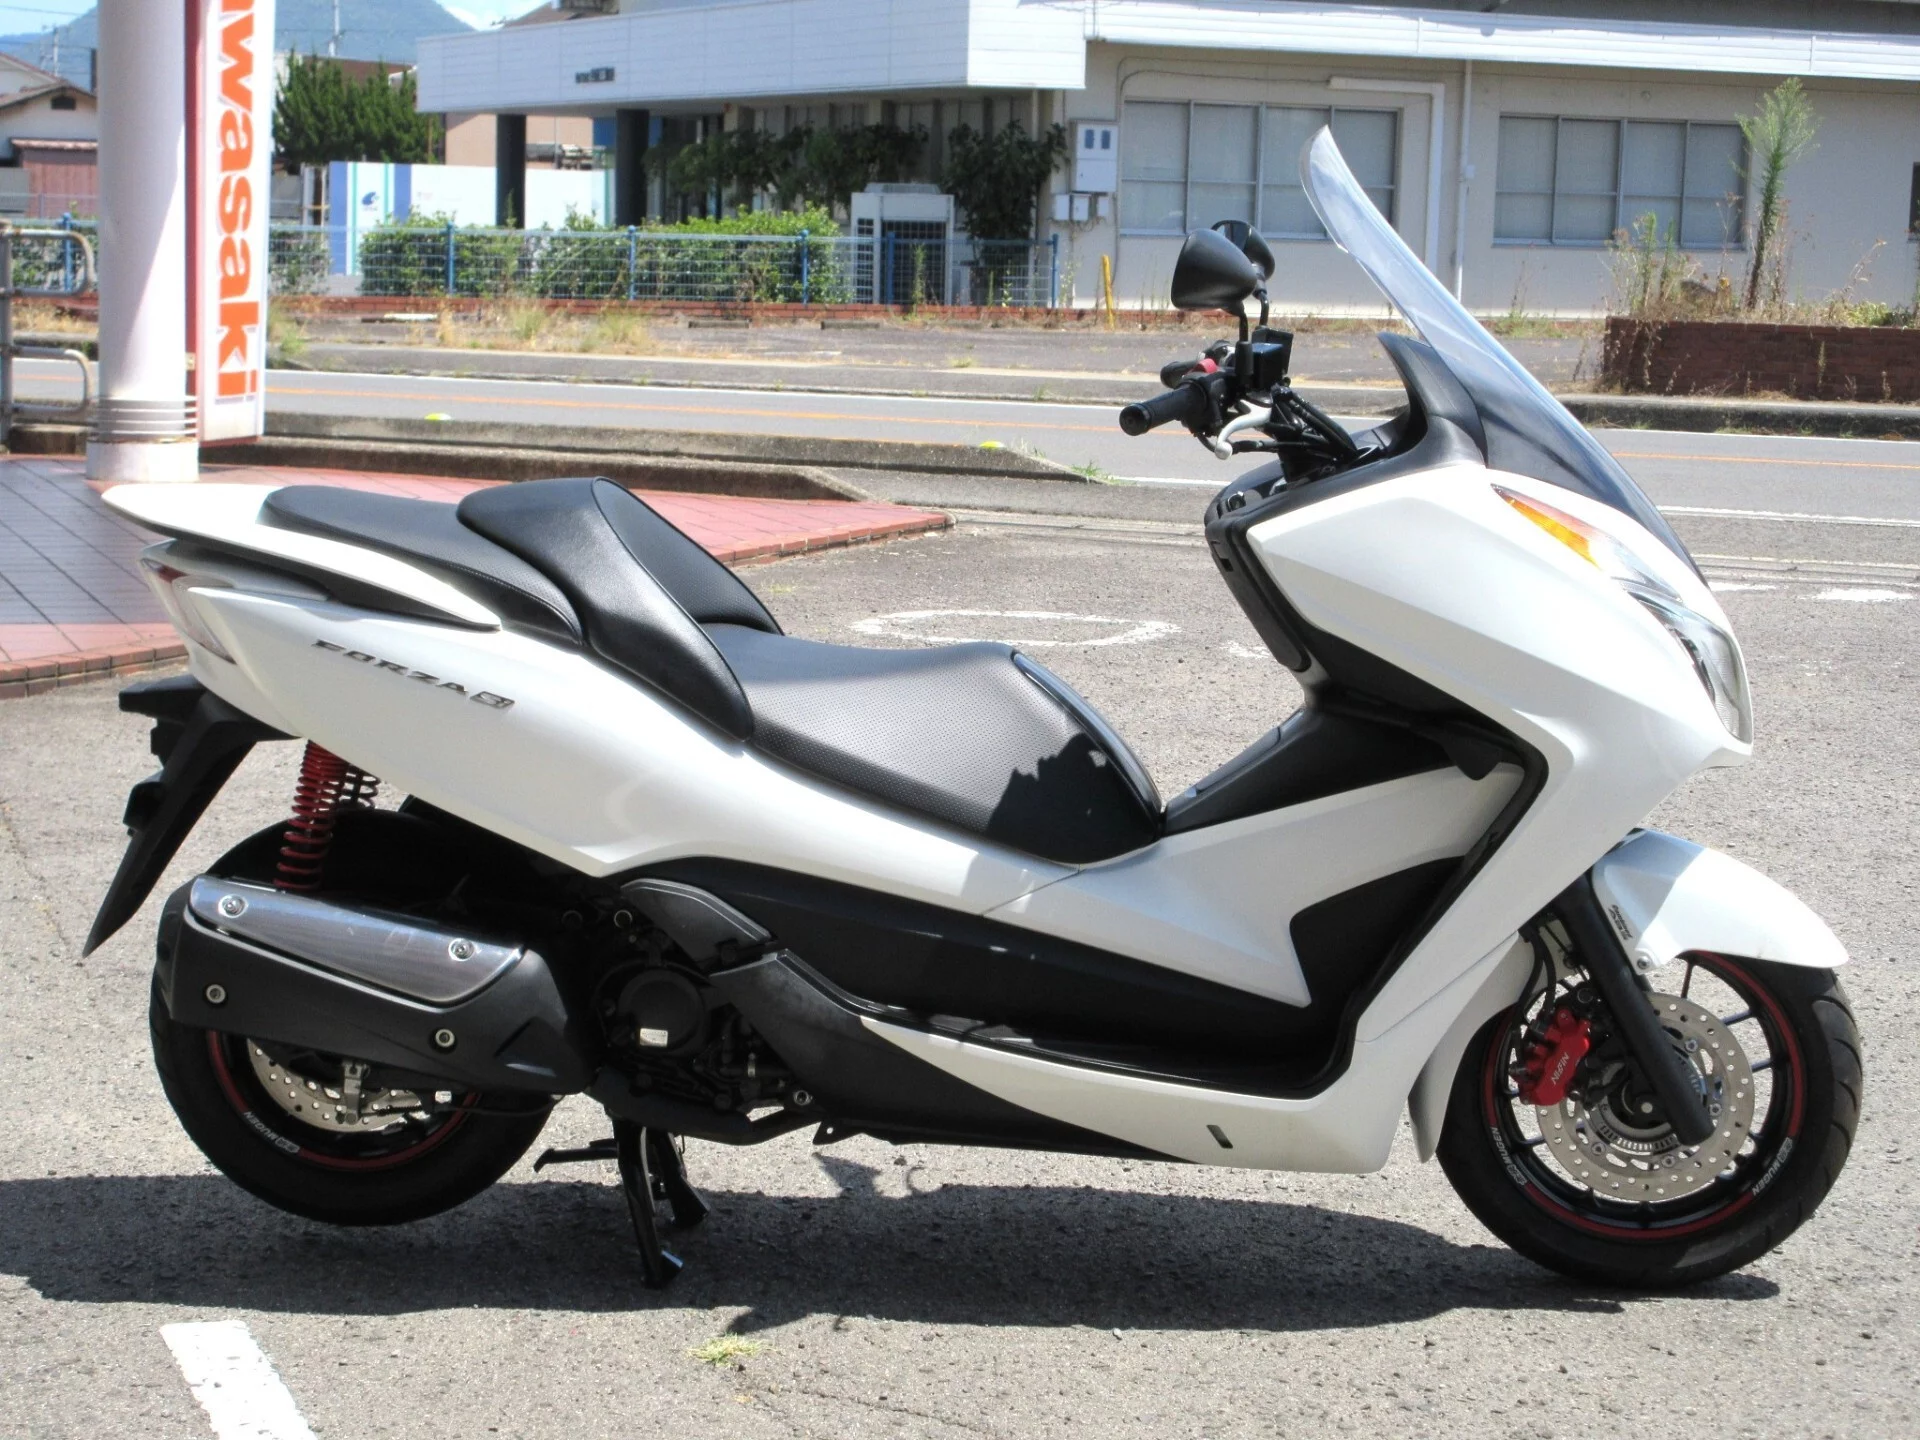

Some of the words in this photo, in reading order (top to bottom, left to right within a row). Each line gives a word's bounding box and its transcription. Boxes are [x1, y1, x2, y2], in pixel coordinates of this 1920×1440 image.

[219, 0, 259, 397] wasaki
[311, 639, 468, 696] FORZA
[243, 1111, 279, 1141] MUGEN
[1490, 1127, 1513, 1165] MUGEN
[1751, 1158, 1781, 1196] MUGEN
